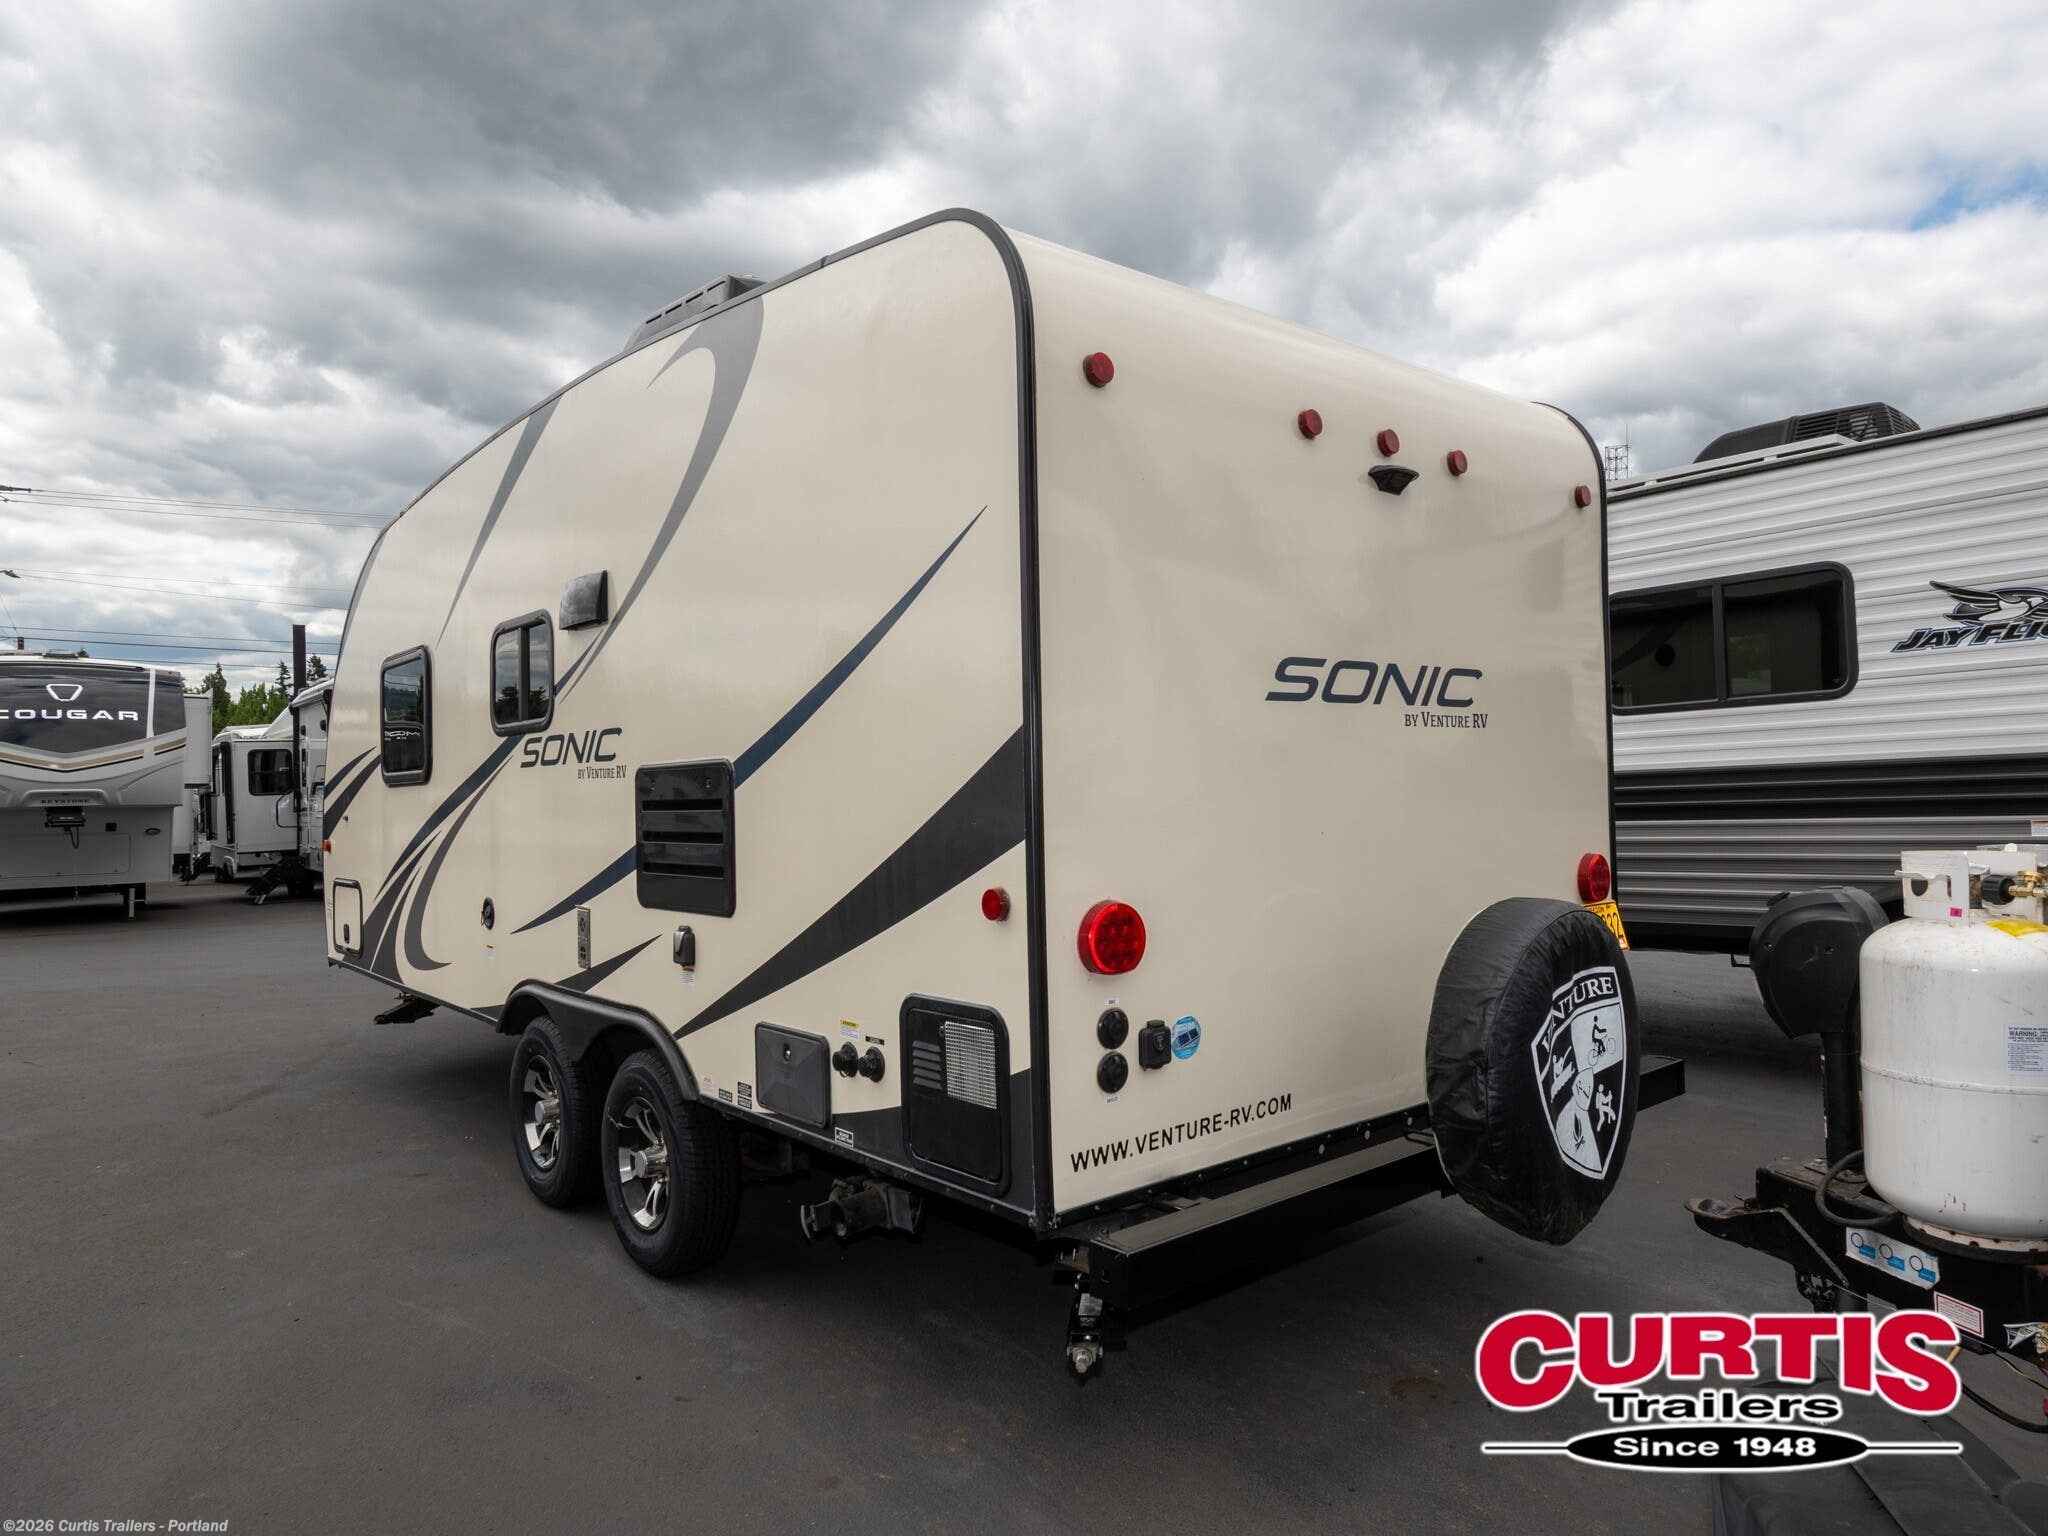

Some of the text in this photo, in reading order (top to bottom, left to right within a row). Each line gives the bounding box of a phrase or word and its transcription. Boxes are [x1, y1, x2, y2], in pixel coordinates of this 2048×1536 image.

[1891, 628, 1977, 652] JAY
[1265, 657, 1483, 708] SONIC
[1472, 713, 1488, 728] RV
[520, 727, 622, 768] SONIC
[616, 765, 627, 779] RV
[1070, 1093, 1292, 1173] WWW.VENTURE-RV.COM
